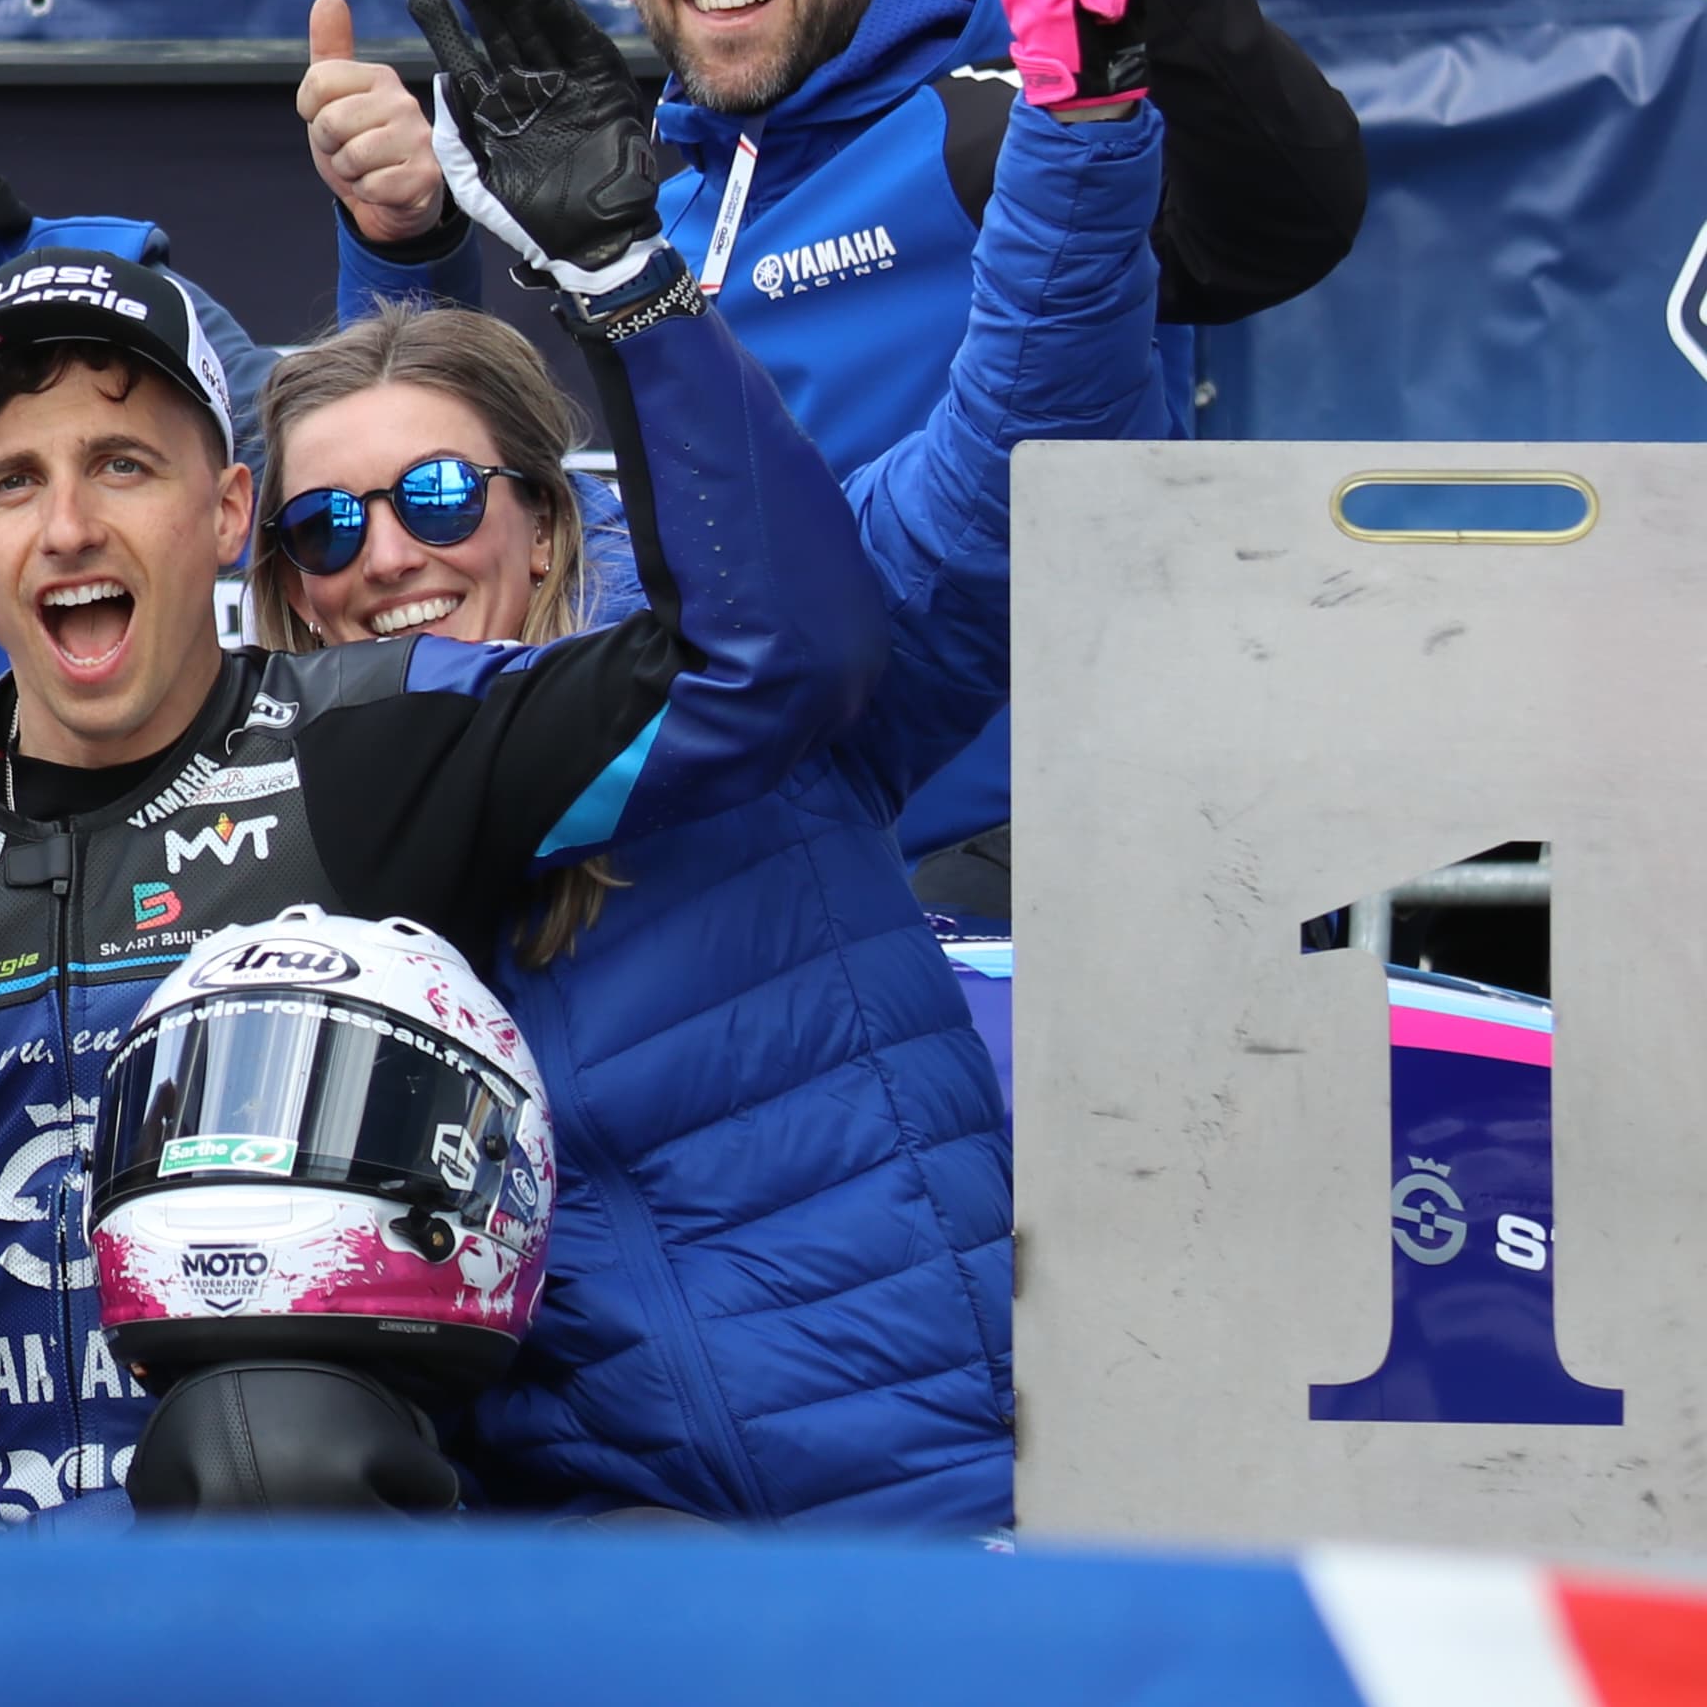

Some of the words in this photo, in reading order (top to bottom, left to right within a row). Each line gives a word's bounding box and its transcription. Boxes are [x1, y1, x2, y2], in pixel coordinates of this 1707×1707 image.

[783, 225, 896, 282] YAMAHA
[768, 259, 893, 300] RACING
[126, 752, 220, 830] YAMAHA
[224, 943, 343, 973] Arai
[107, 998, 472, 1081] www.kevin-rousseau.fr
[168, 1140, 228, 1162] Sarthe
[1300, 840, 1624, 1426] 1
[181, 1252, 268, 1277] MOTO
